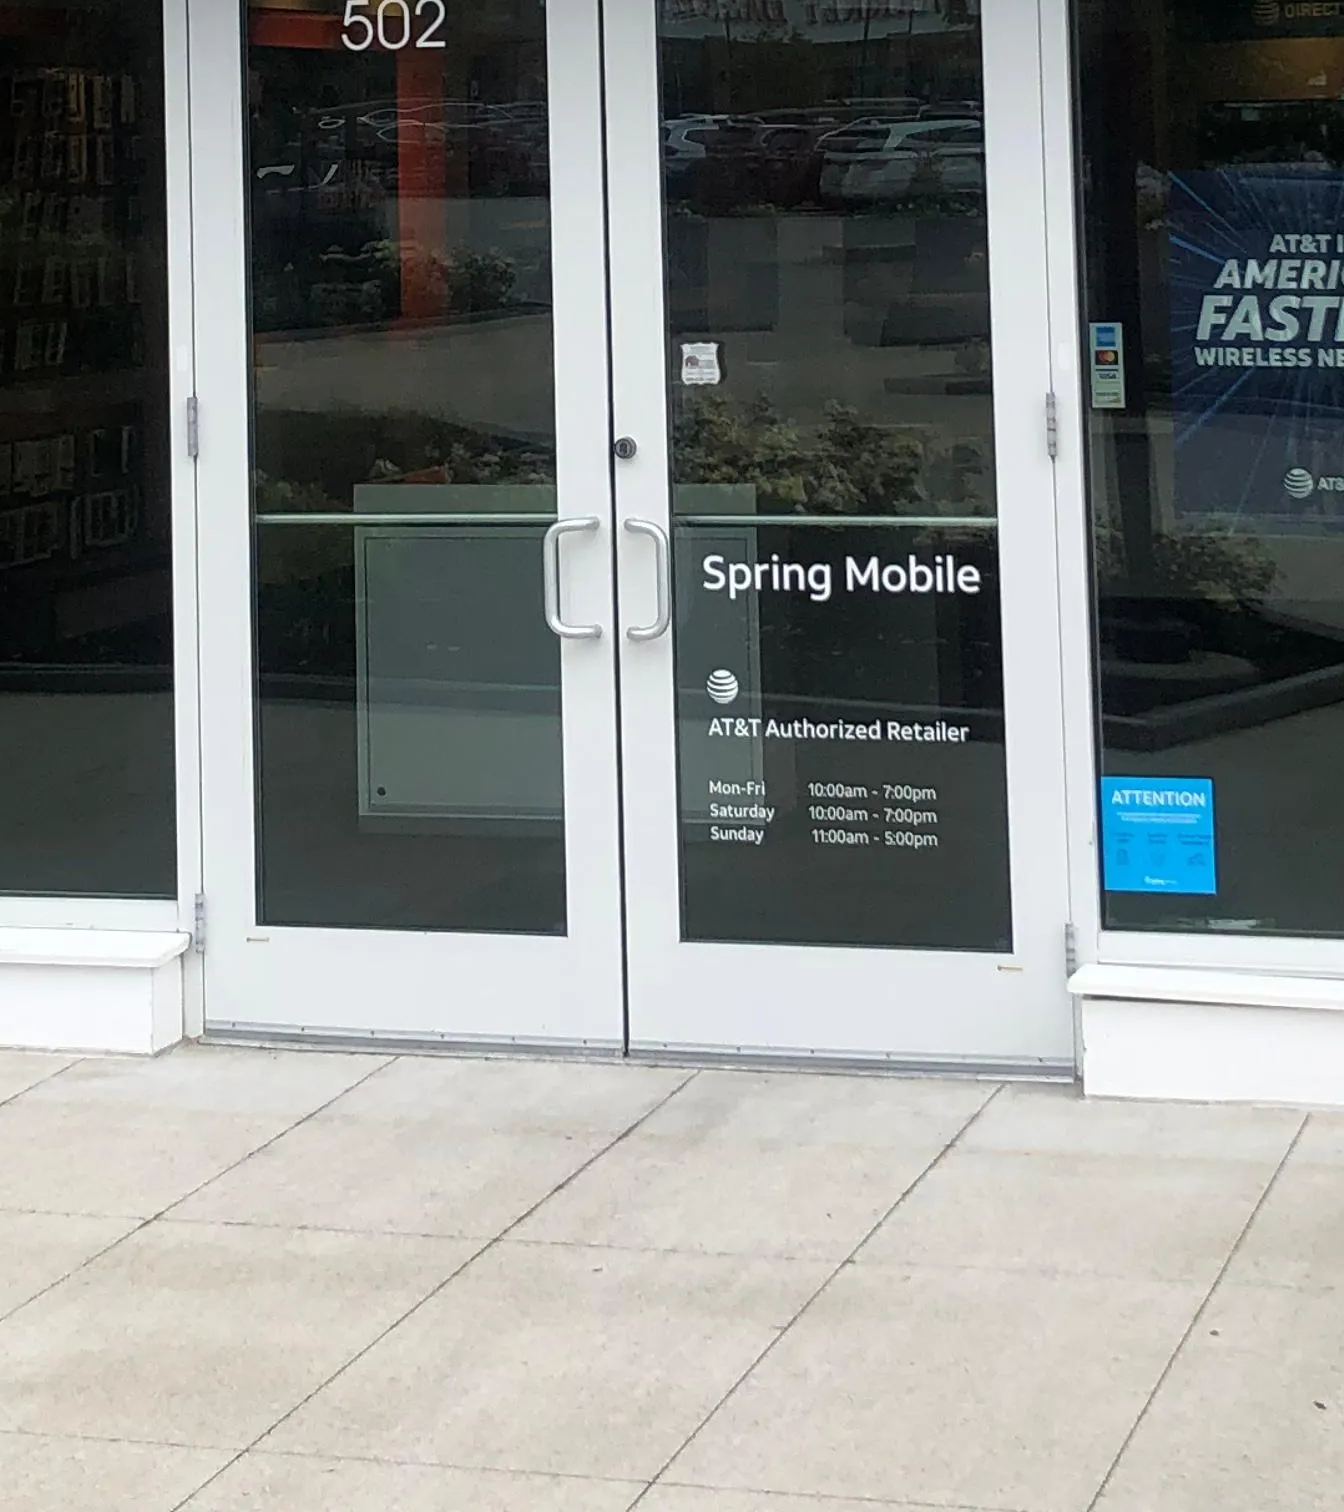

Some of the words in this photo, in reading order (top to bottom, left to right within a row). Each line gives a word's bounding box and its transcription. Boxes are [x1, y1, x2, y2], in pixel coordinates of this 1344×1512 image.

[1269, 234, 1332, 253] AT&T
[1194, 347, 1312, 368] WIRELESS
[702, 555, 832, 600] Spring
[845, 555, 981, 595] Mobile
[708, 718, 761, 739] AT&T
[765, 719, 882, 741] Authorized
[887, 721, 970, 743] Retailer
[709, 780, 765, 797] Mon-Fri
[808, 783, 868, 799] 10:00am
[883, 784, 937, 802] 7:00pm
[1112, 790, 1206, 808] ATTENTION
[710, 804, 775, 822] Saturday
[808, 805, 869, 823] 10:00am
[883, 807, 938, 825] 7:00pm
[710, 827, 764, 845] Sunday
[811, 829, 869, 846] 11:00am
[884, 830, 938, 849] 5:00pm
